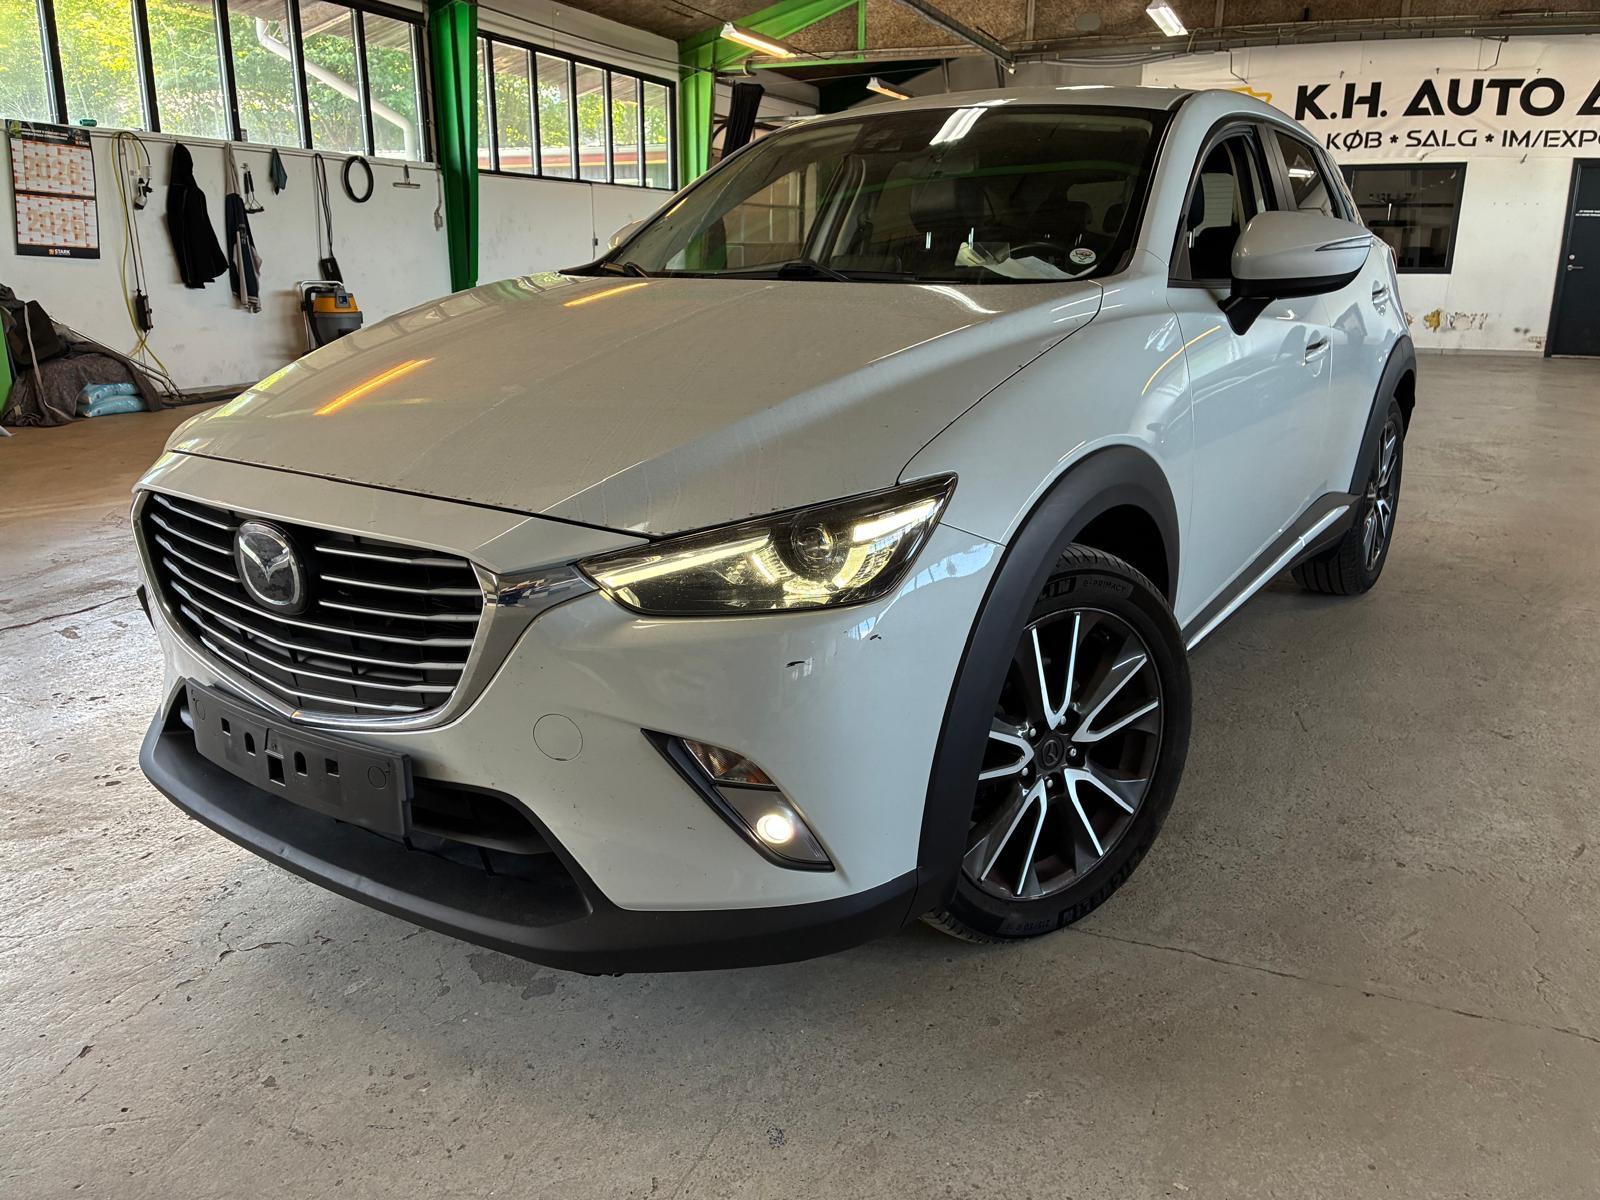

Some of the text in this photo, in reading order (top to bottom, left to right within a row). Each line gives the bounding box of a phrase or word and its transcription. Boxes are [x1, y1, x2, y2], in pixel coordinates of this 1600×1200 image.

[1295, 81, 1388, 121] K.H.
[1402, 77, 1566, 117] AUTO
[1326, 129, 1600, 152] KØB SALG IM/EXP
